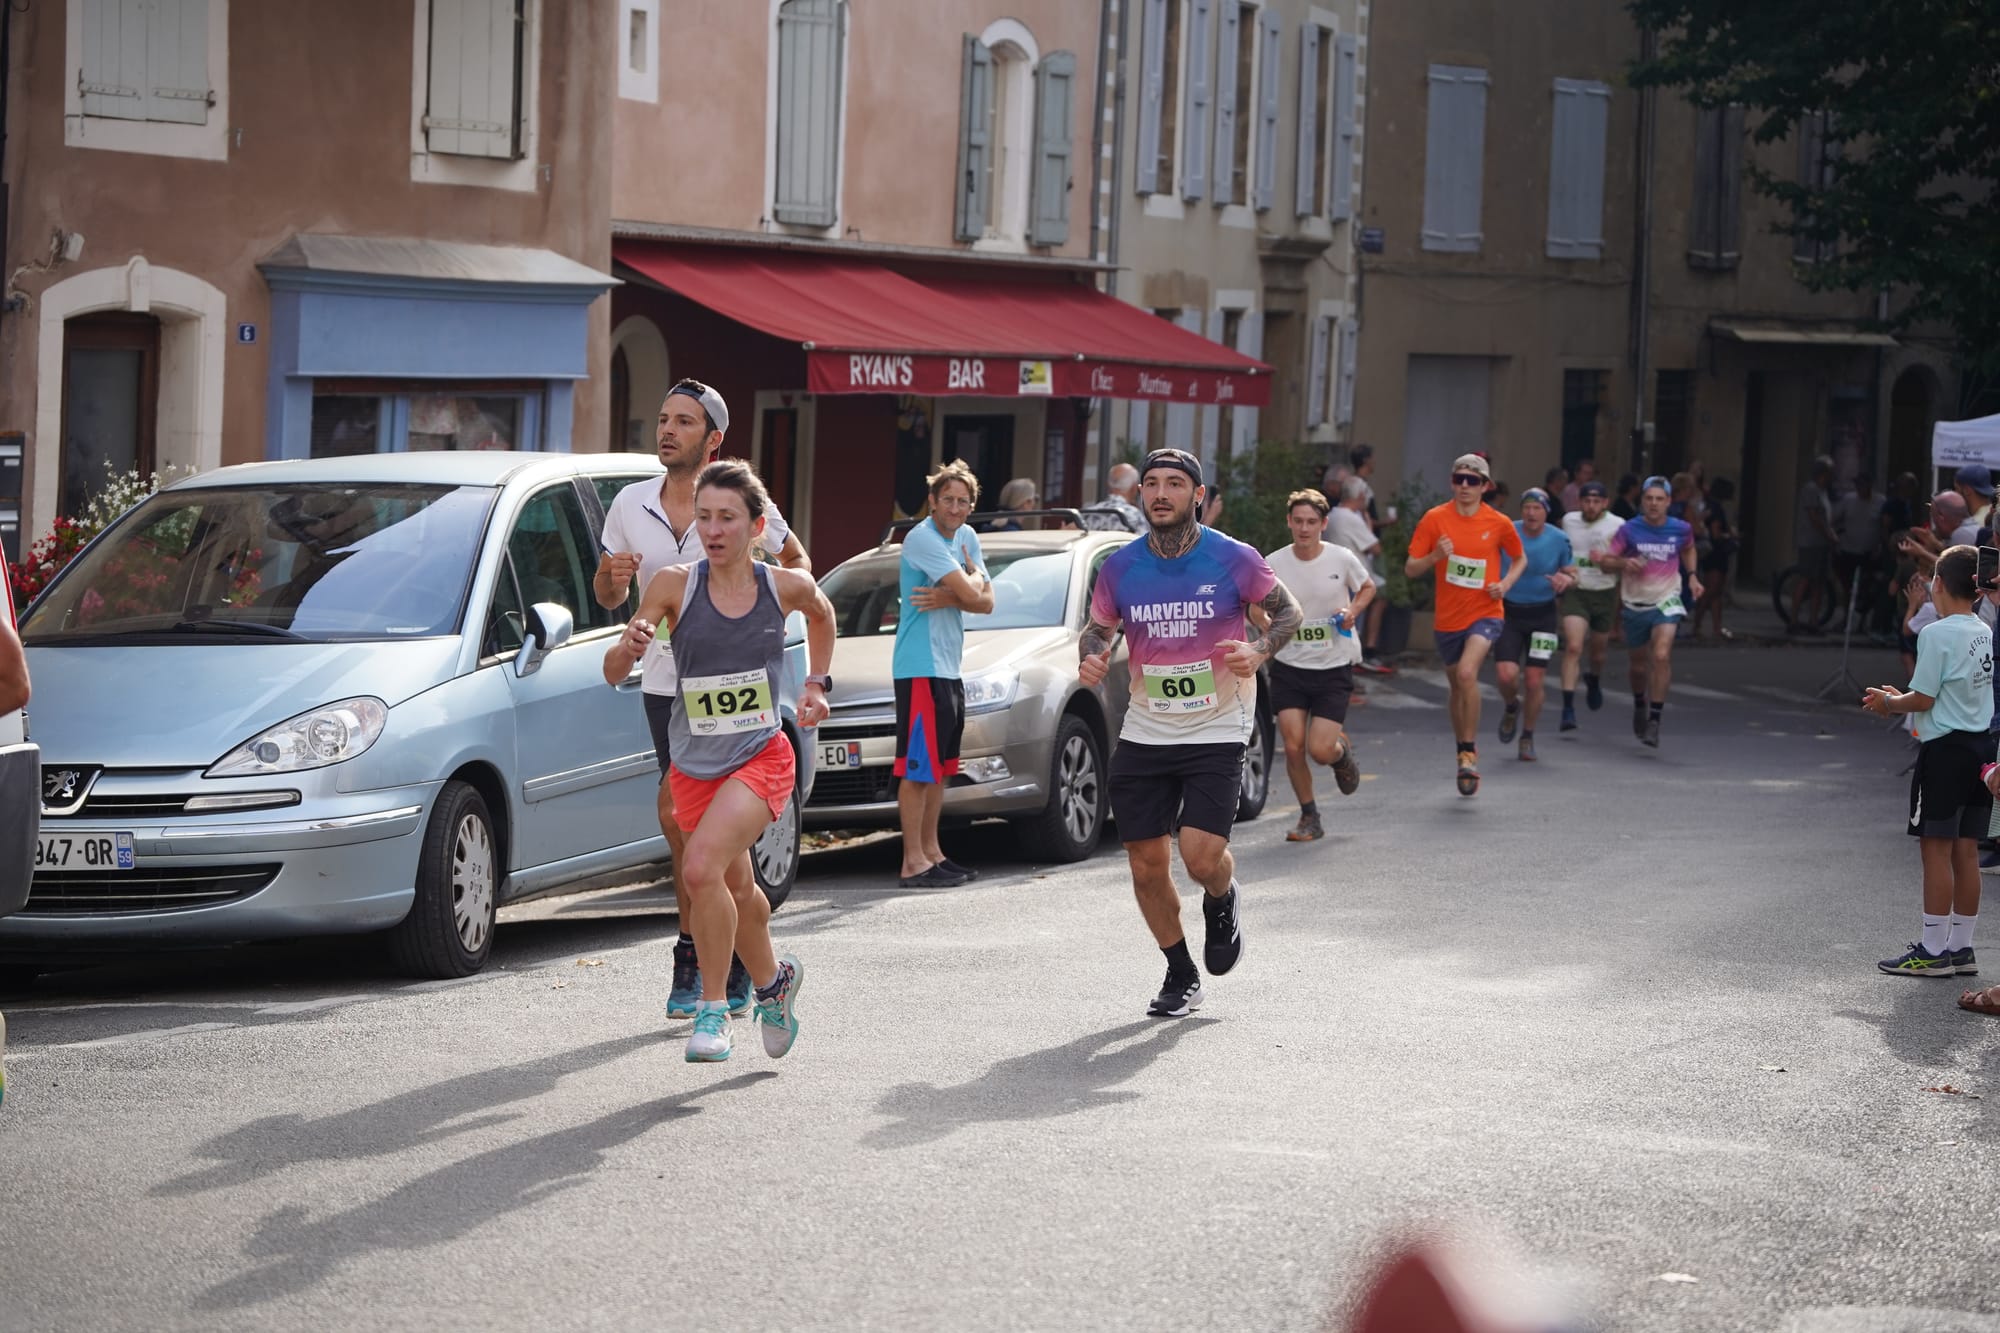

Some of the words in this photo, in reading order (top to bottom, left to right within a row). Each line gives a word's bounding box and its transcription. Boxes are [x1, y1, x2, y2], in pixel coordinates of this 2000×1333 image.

[243, 326, 251, 341] 6
[849, 354, 914, 386] RYAN'S
[947, 358, 986, 389] BAR
[1456, 564, 1477, 579] 97
[1129, 600, 1215, 622] MARVEJOLS
[1146, 620, 1198, 639] MENDE
[1296, 627, 1325, 642] 189
[1161, 677, 1196, 698] 60
[697, 687, 760, 716] 192
[118, 850, 132, 864] 59
